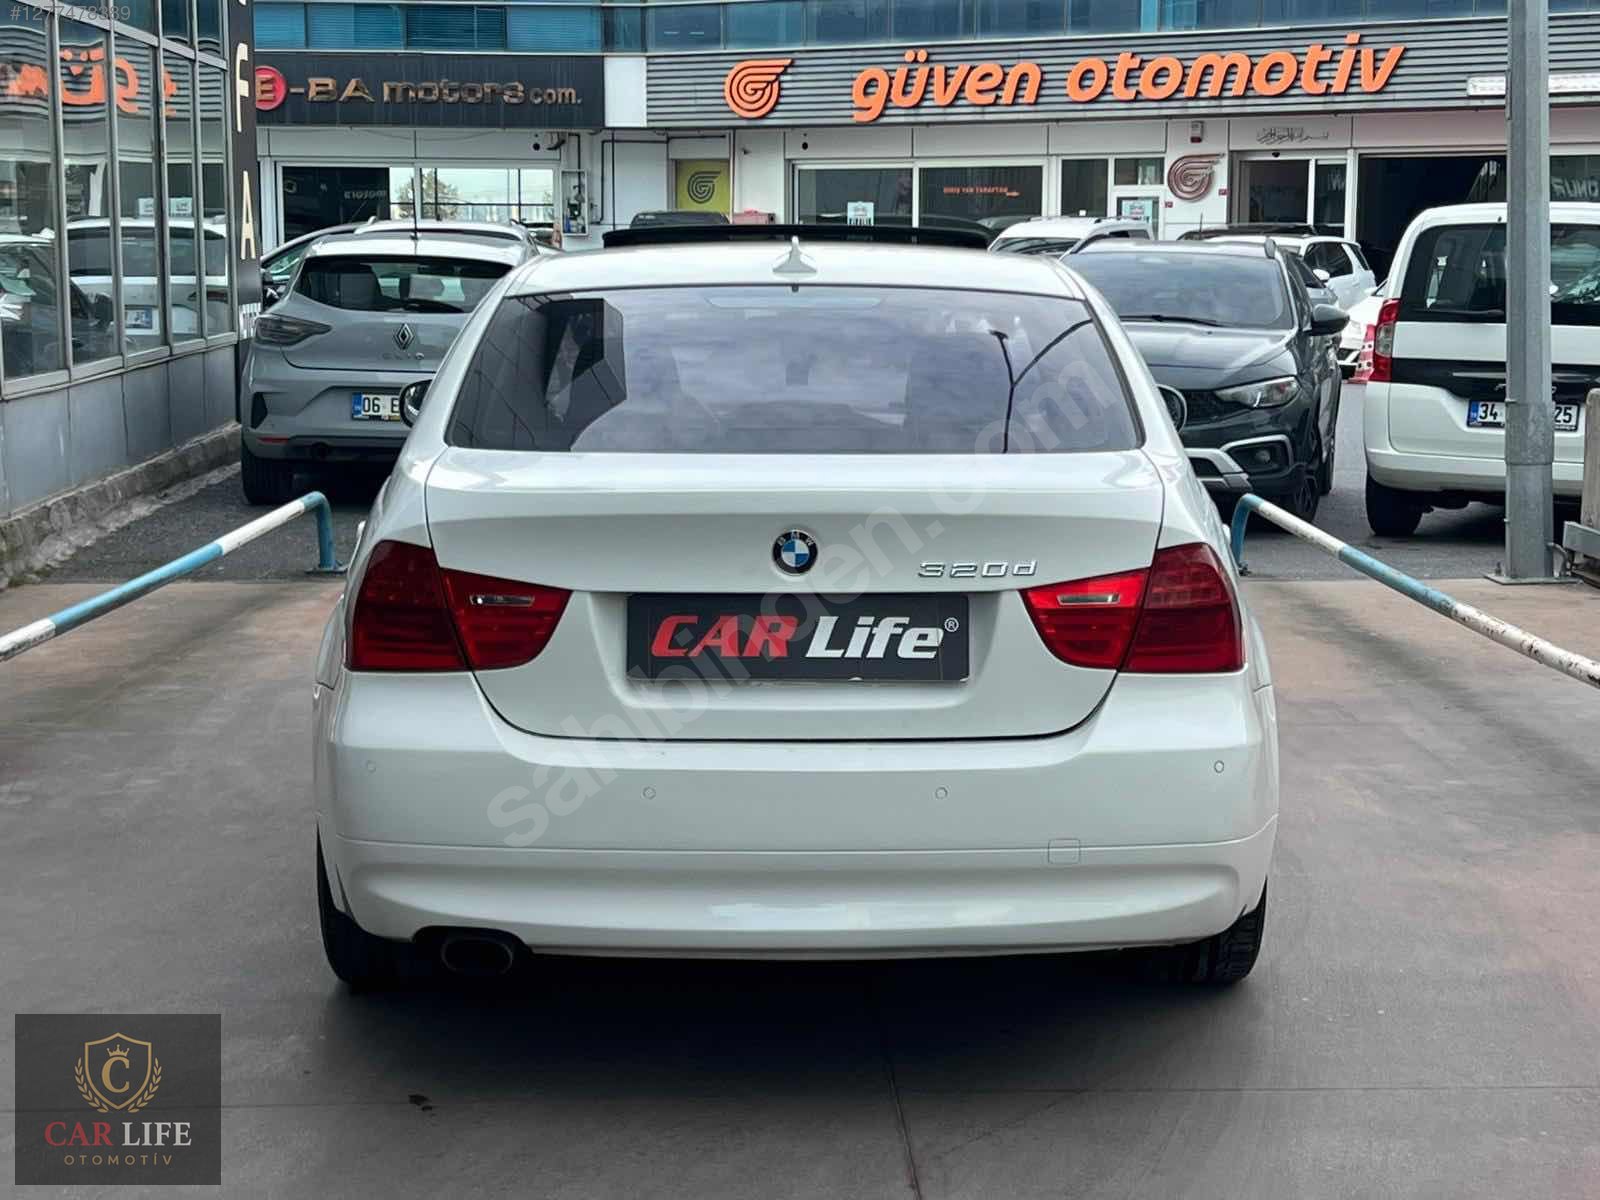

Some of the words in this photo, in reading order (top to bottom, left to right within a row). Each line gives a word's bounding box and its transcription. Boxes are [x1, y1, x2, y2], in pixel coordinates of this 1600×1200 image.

[852, 50, 1041, 122] güven
[1066, 33, 1406, 101] otomotiv
[383, 79, 524, 104] motors
[362, 397, 381, 413] 06
[1479, 403, 1498, 420] 34
[1553, 406, 1573, 423] 25
[918, 560, 1039, 578] 320d
[651, 615, 798, 657] CAR
